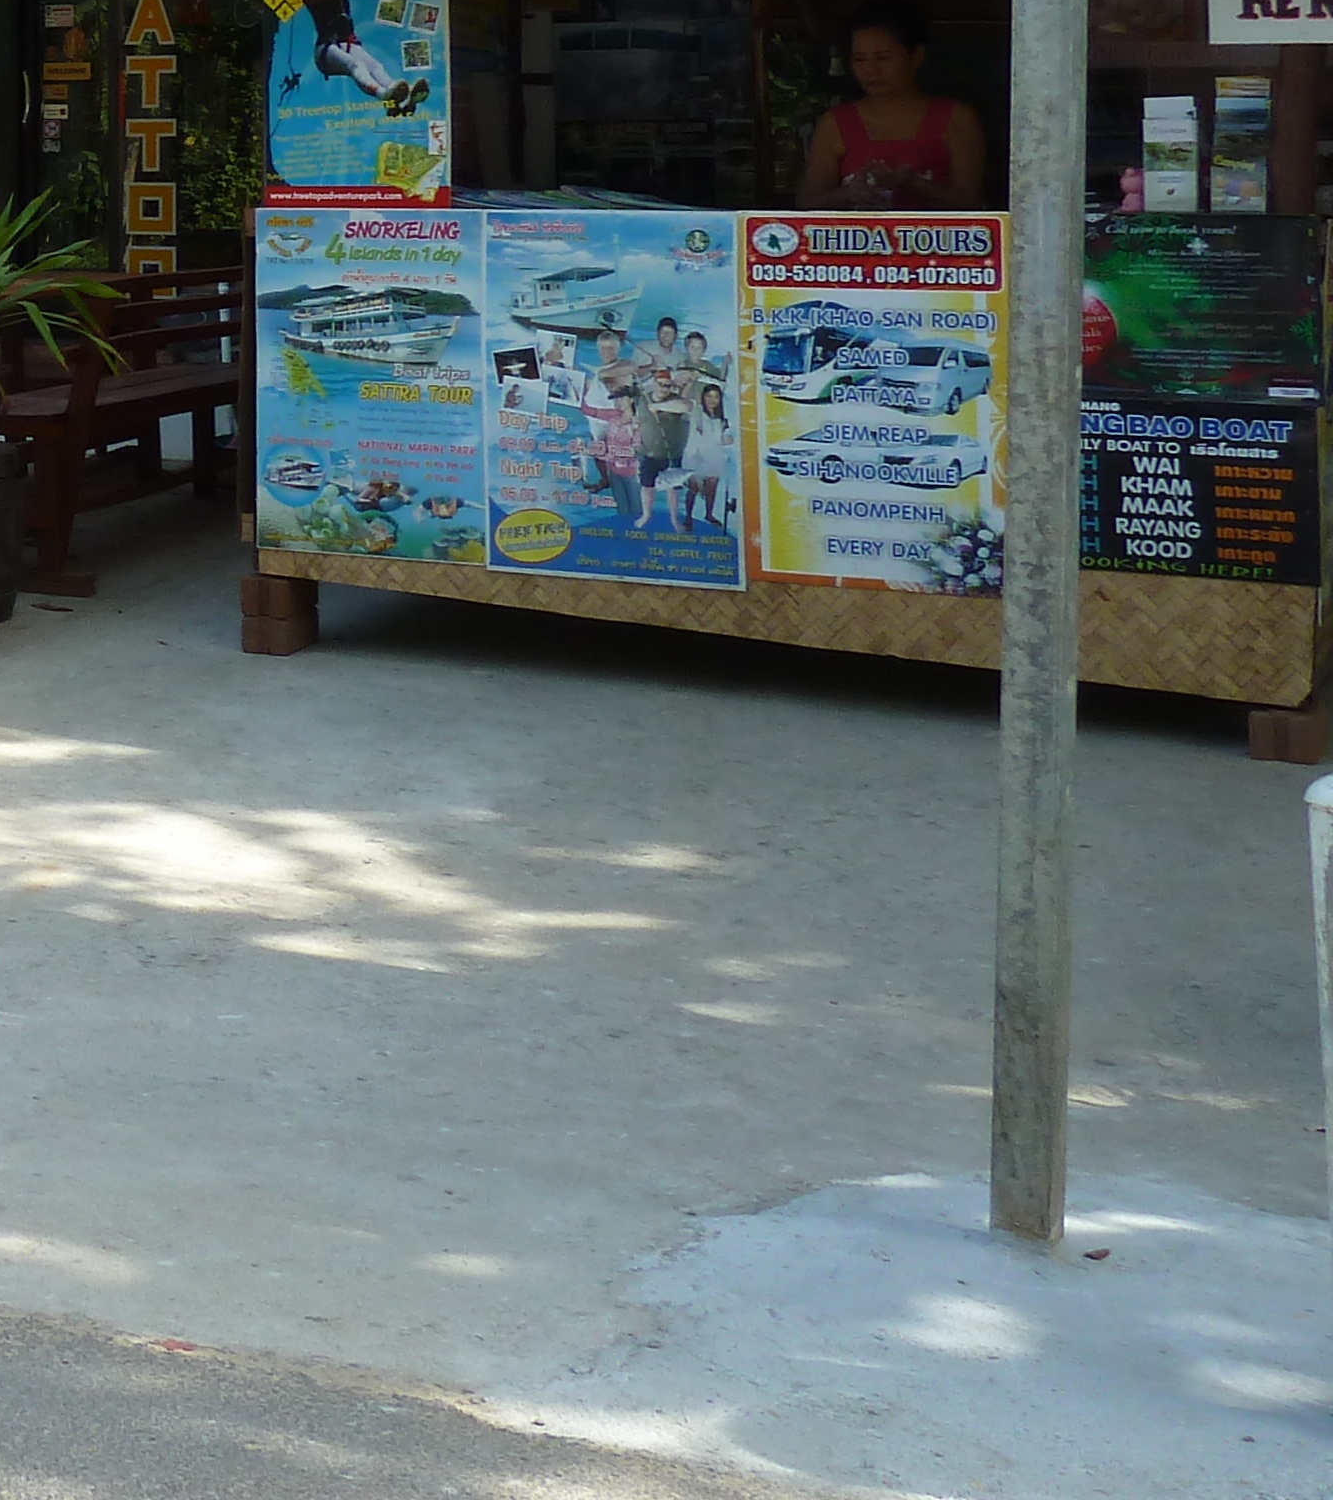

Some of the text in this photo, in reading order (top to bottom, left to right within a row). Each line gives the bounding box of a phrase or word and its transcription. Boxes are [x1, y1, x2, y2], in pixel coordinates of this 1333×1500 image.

[344, 220, 461, 240] SNORKELING
[805, 225, 990, 254] THIDA TOURS
[324, 233, 347, 265] 4
[348, 246, 401, 261] islands
[404, 247, 417, 261] in
[421, 247, 431, 261] 1
[433, 245, 461, 267] day
[752, 264, 996, 286] 039-538084 084-1073050
[809, 308, 874, 328] (KHAO
[881, 311, 923, 328] SAN
[931, 312, 998, 332] ROAD)
[837, 347, 909, 367] SAMED
[392, 363, 470, 385] Boat trips
[360, 381, 473, 404] SATTRA TOUR
[833, 386, 917, 406] PATTAYA
[499, 411, 529, 432] Day
[538, 412, 569, 434] Trip
[1199, 417, 1292, 443] BOAT
[823, 424, 929, 444] SIEM REAP
[358, 440, 476, 456] NATIONAL MARINE PARK
[1106, 440, 1181, 454] BOAT TO
[500, 459, 582, 484] Night Trip
[798, 460, 958, 485] SIHANOOKVILLE
[1133, 456, 1180, 475] WAI
[1121, 476, 1193, 497] KHAM
[812, 500, 945, 524] PANOMPENH
[1122, 497, 1195, 518] MAAK
[1115, 517, 1202, 540] RAYANG
[827, 538, 932, 560] EVERY DAY
[1126, 539, 1193, 559] KOOD
